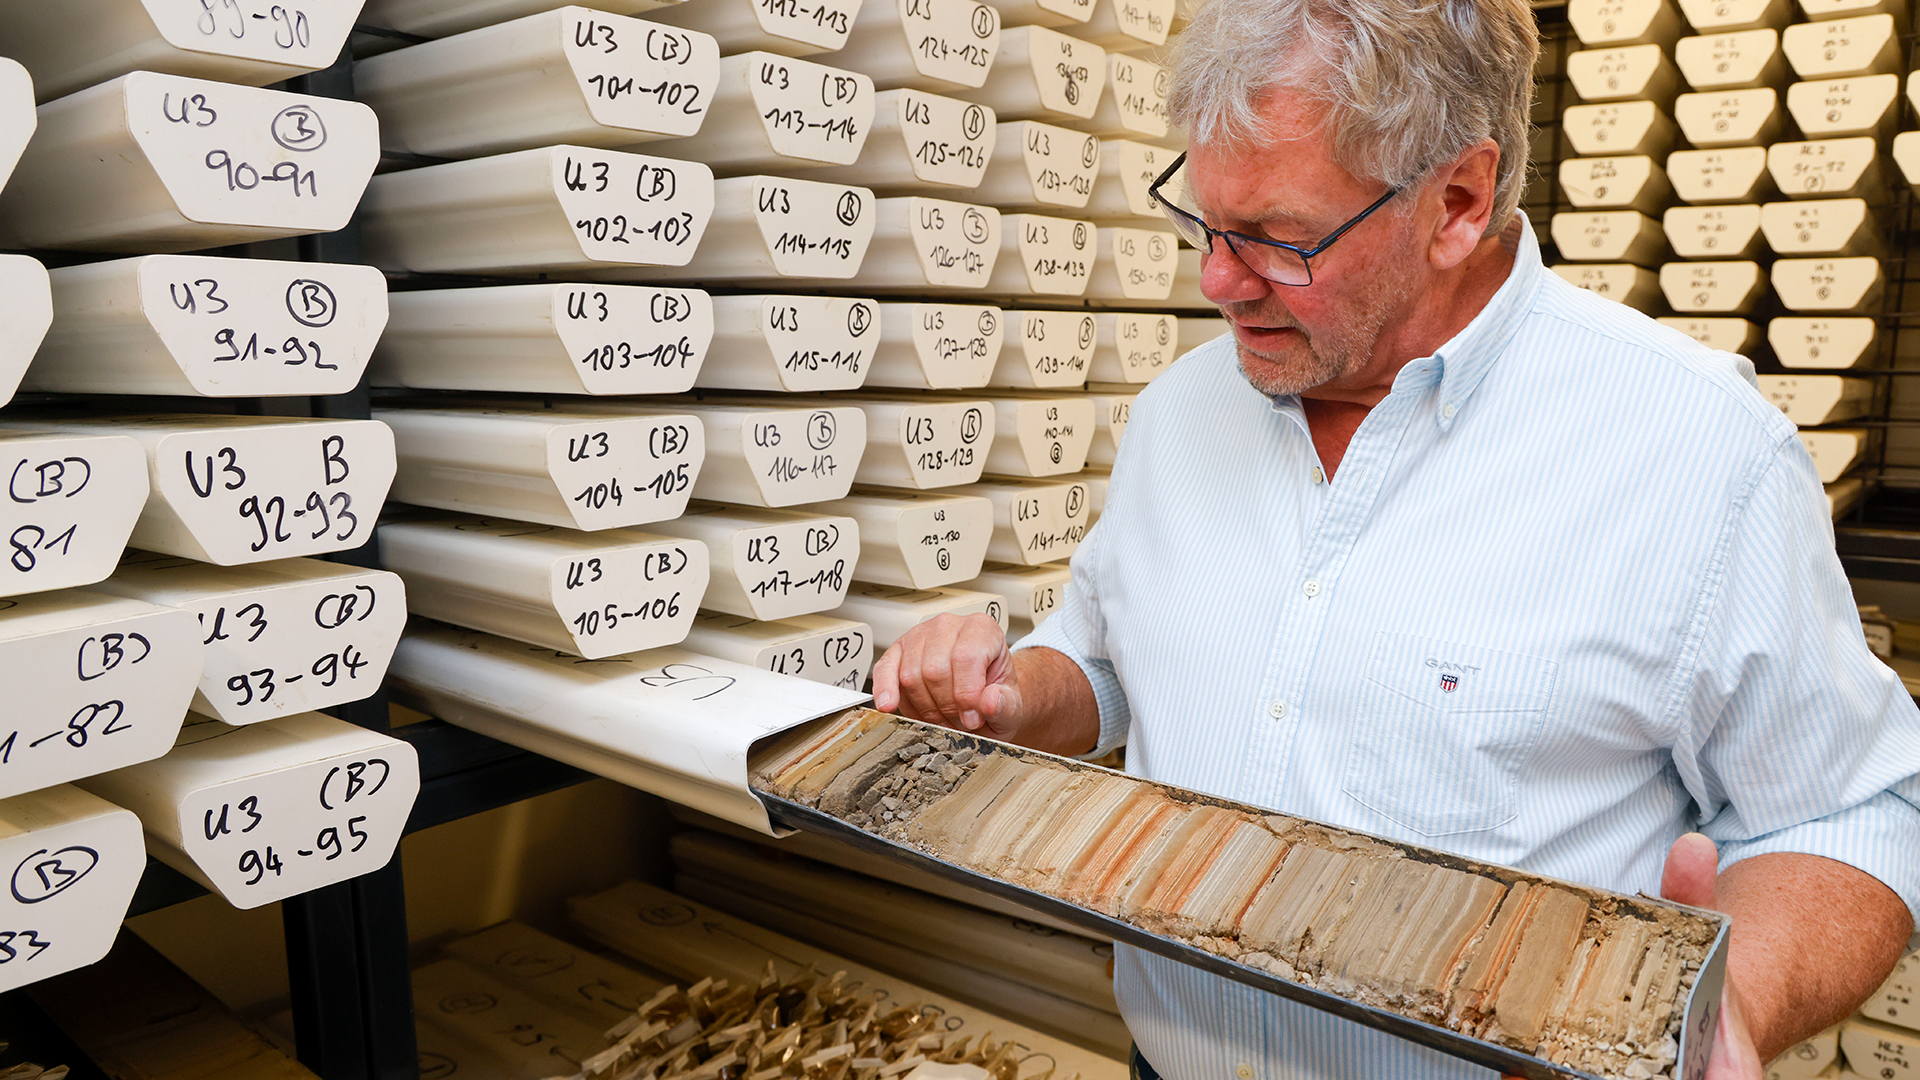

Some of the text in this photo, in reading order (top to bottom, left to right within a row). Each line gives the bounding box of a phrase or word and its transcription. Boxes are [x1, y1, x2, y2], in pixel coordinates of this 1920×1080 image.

[762, 0, 847, 36] 112-113
[907, 0, 931, 20] U3
[576, 21, 691, 65] U3 (B)
[918, 36, 990, 67] 124-125
[1061, 42, 1072, 57] U3
[762, 63, 857, 107] U3 (B)
[1117, 63, 1132, 83] U3
[588, 75, 702, 114] 101-102
[163, 93, 216, 126] U3
[906, 98, 930, 124] U3
[765, 108, 857, 142] 113-114
[916, 141, 983, 168] 125-126
[1029, 130, 1050, 156] U3
[205, 149, 318, 198] 90-91
[565, 157, 675, 202] U3 (B)
[1037, 169, 1089, 195] 137-138
[759, 188, 790, 214] U3
[576, 212, 692, 246] 102-103
[921, 207, 944, 230] U3
[775, 233, 851, 259] 114-115
[1027, 223, 1048, 244] U3
[1120, 237, 1135, 256] U3
[930, 246, 984, 273] 126-127
[1034, 259, 1084, 277] 138-139
[170, 279, 228, 314] U3
[568, 292, 690, 323] U3 (B)
[771, 306, 798, 331] U3
[924, 312, 944, 330] U3
[1028, 319, 1044, 341] U3
[1124, 323, 1138, 338] U3
[214, 329, 338, 370] 91-92
[582, 336, 694, 371] 103-104
[785, 350, 861, 373] 115-116
[935, 338, 986, 359] 127-128
[1036, 356, 1083, 373] 139-140
[1047, 408, 1057, 420] U3
[568, 426, 688, 462] U3 (B)
[755, 424, 780, 447] U3
[907, 417, 933, 444] U3
[186, 436, 349, 498] U3 B
[768, 455, 837, 482] 116-117
[918, 448, 973, 470] 128-129
[9, 457, 90, 503] (B)
[239, 490, 358, 552] 92-93
[935, 510, 945, 521] U3
[1019, 500, 1039, 521] U3
[748, 524, 839, 564] U3 (B)
[921, 530, 960, 545] 129-130
[567, 548, 687, 589] U3 (B)
[750, 559, 846, 599] 117-118
[315, 585, 375, 629] (B)
[574, 592, 680, 635] 105-106
[1035, 589, 1053, 613] U3
[78, 633, 150, 681] (B)
[824, 632, 863, 667] (B)
[227, 644, 369, 706] 93-94
[1425, 658, 1481, 675] GANT
[205, 759, 389, 840] U3 (B)
[238, 816, 369, 886] 94-95
